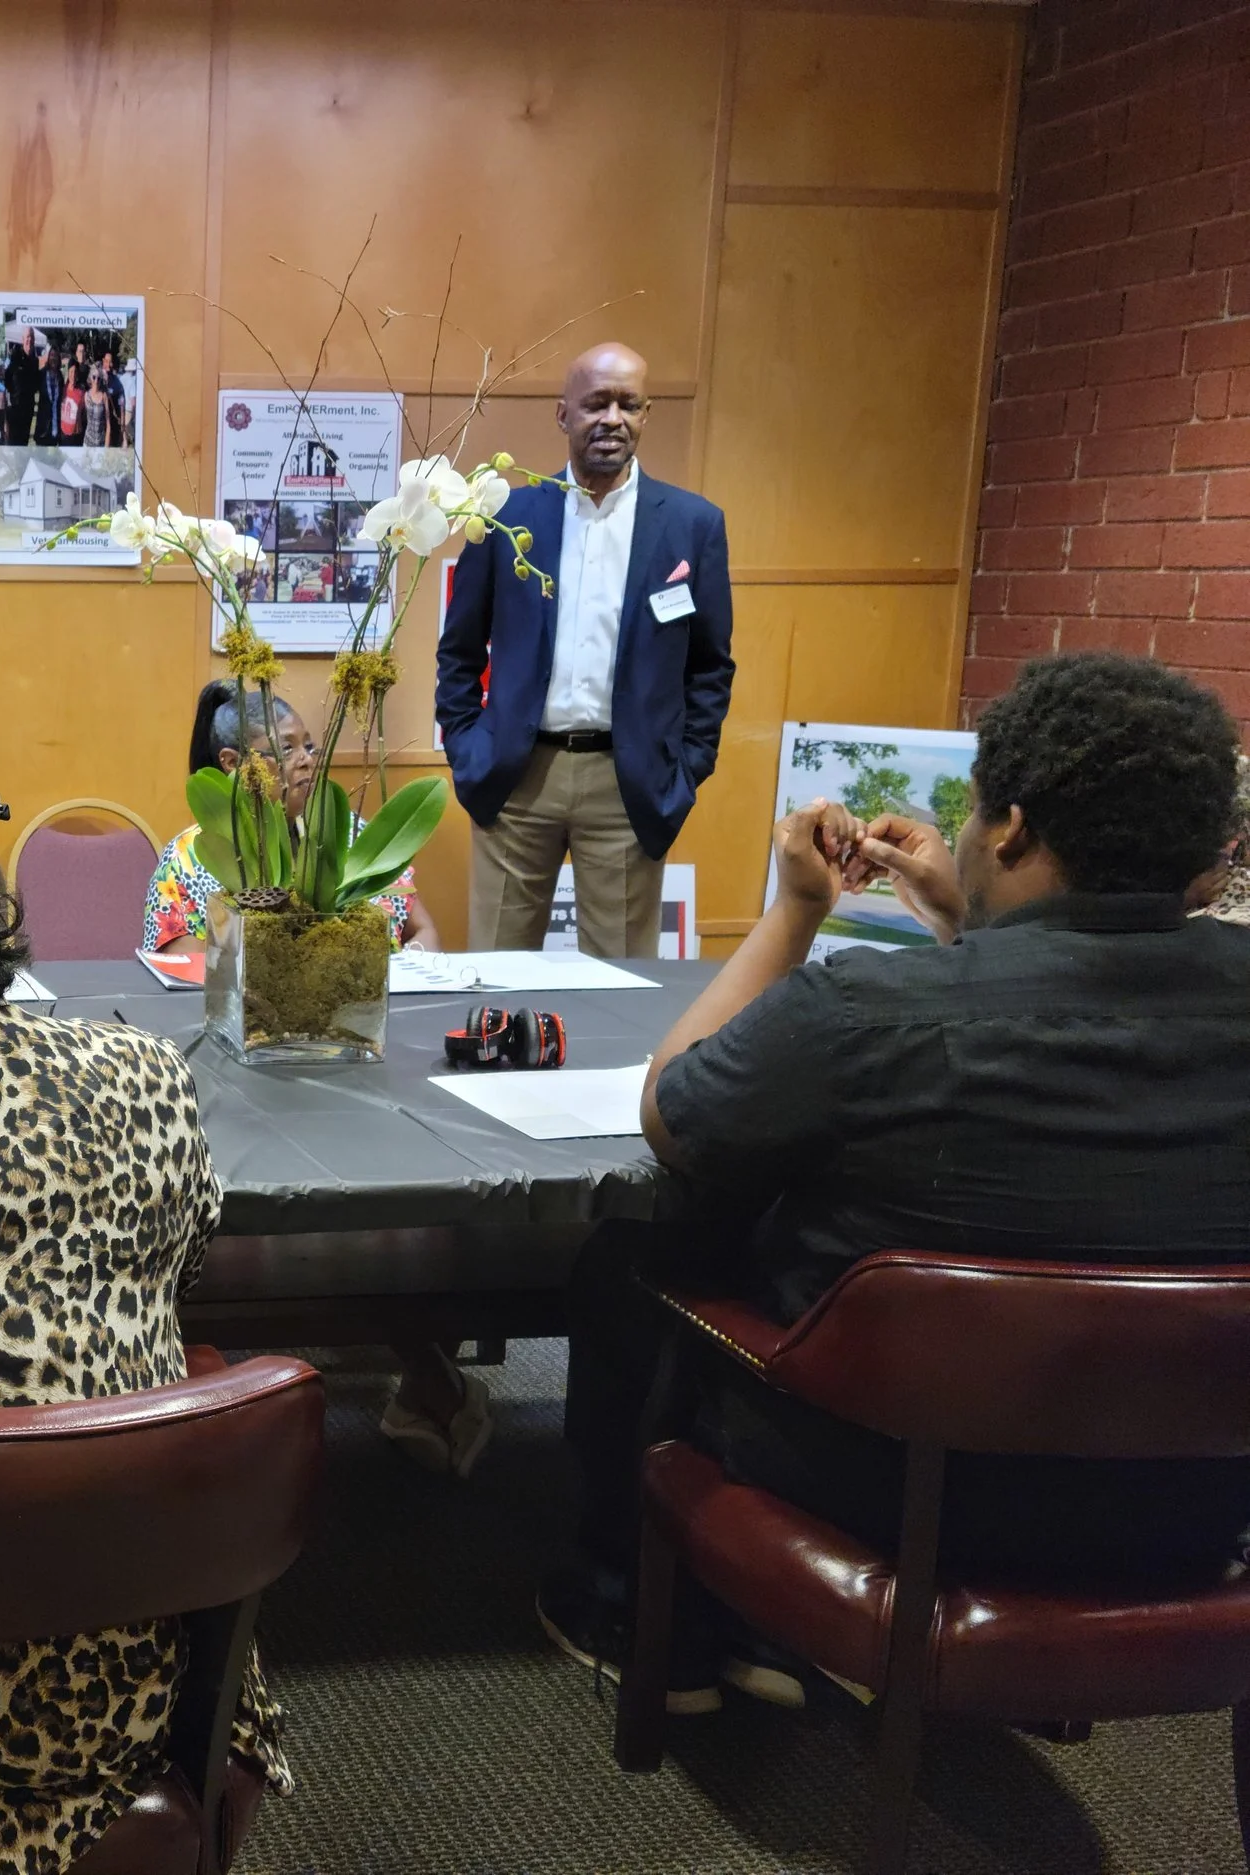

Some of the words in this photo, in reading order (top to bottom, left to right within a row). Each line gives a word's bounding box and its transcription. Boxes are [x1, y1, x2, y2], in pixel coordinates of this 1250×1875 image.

[20, 313, 76, 327] Community
[79, 315, 123, 327] Outreach
[360, 406, 381, 416] Inc.
[321, 432, 344, 441] Living
[233, 450, 273, 459] Community
[348, 451, 389, 460] Community
[348, 462, 388, 471] Organizing
[31, 536, 69, 545] Vetan
[551, 908, 568, 920] rs
